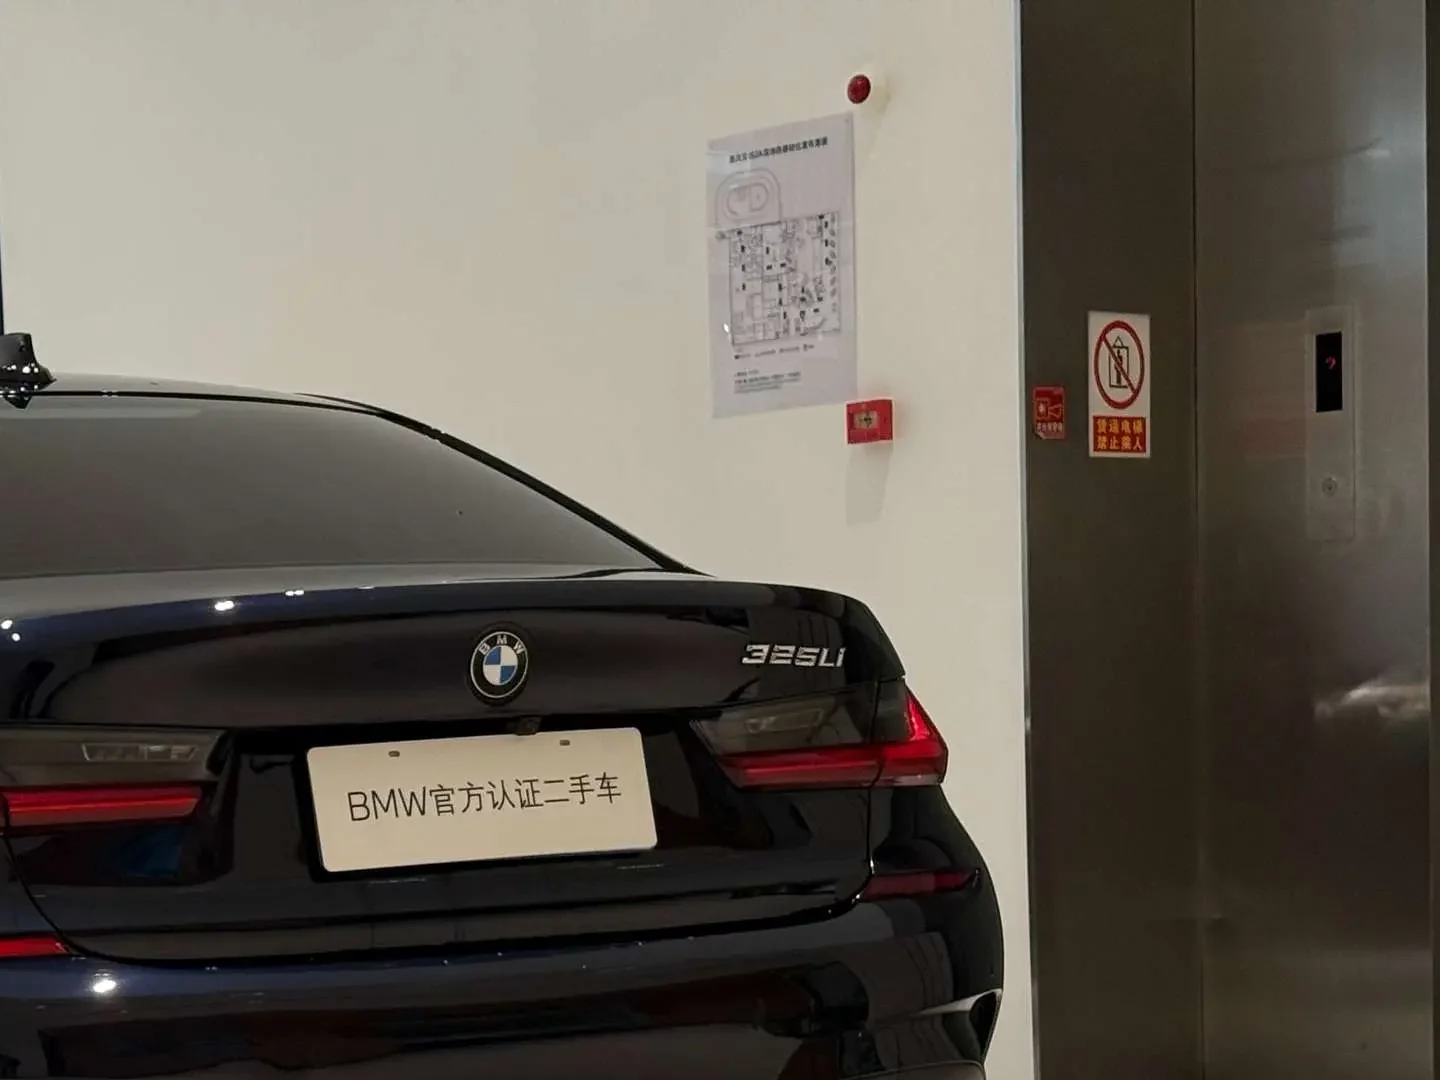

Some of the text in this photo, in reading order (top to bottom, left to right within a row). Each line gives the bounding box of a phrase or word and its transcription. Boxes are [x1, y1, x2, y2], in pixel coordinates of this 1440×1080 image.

[347, 772, 621, 821] BMW官方认证二手车
